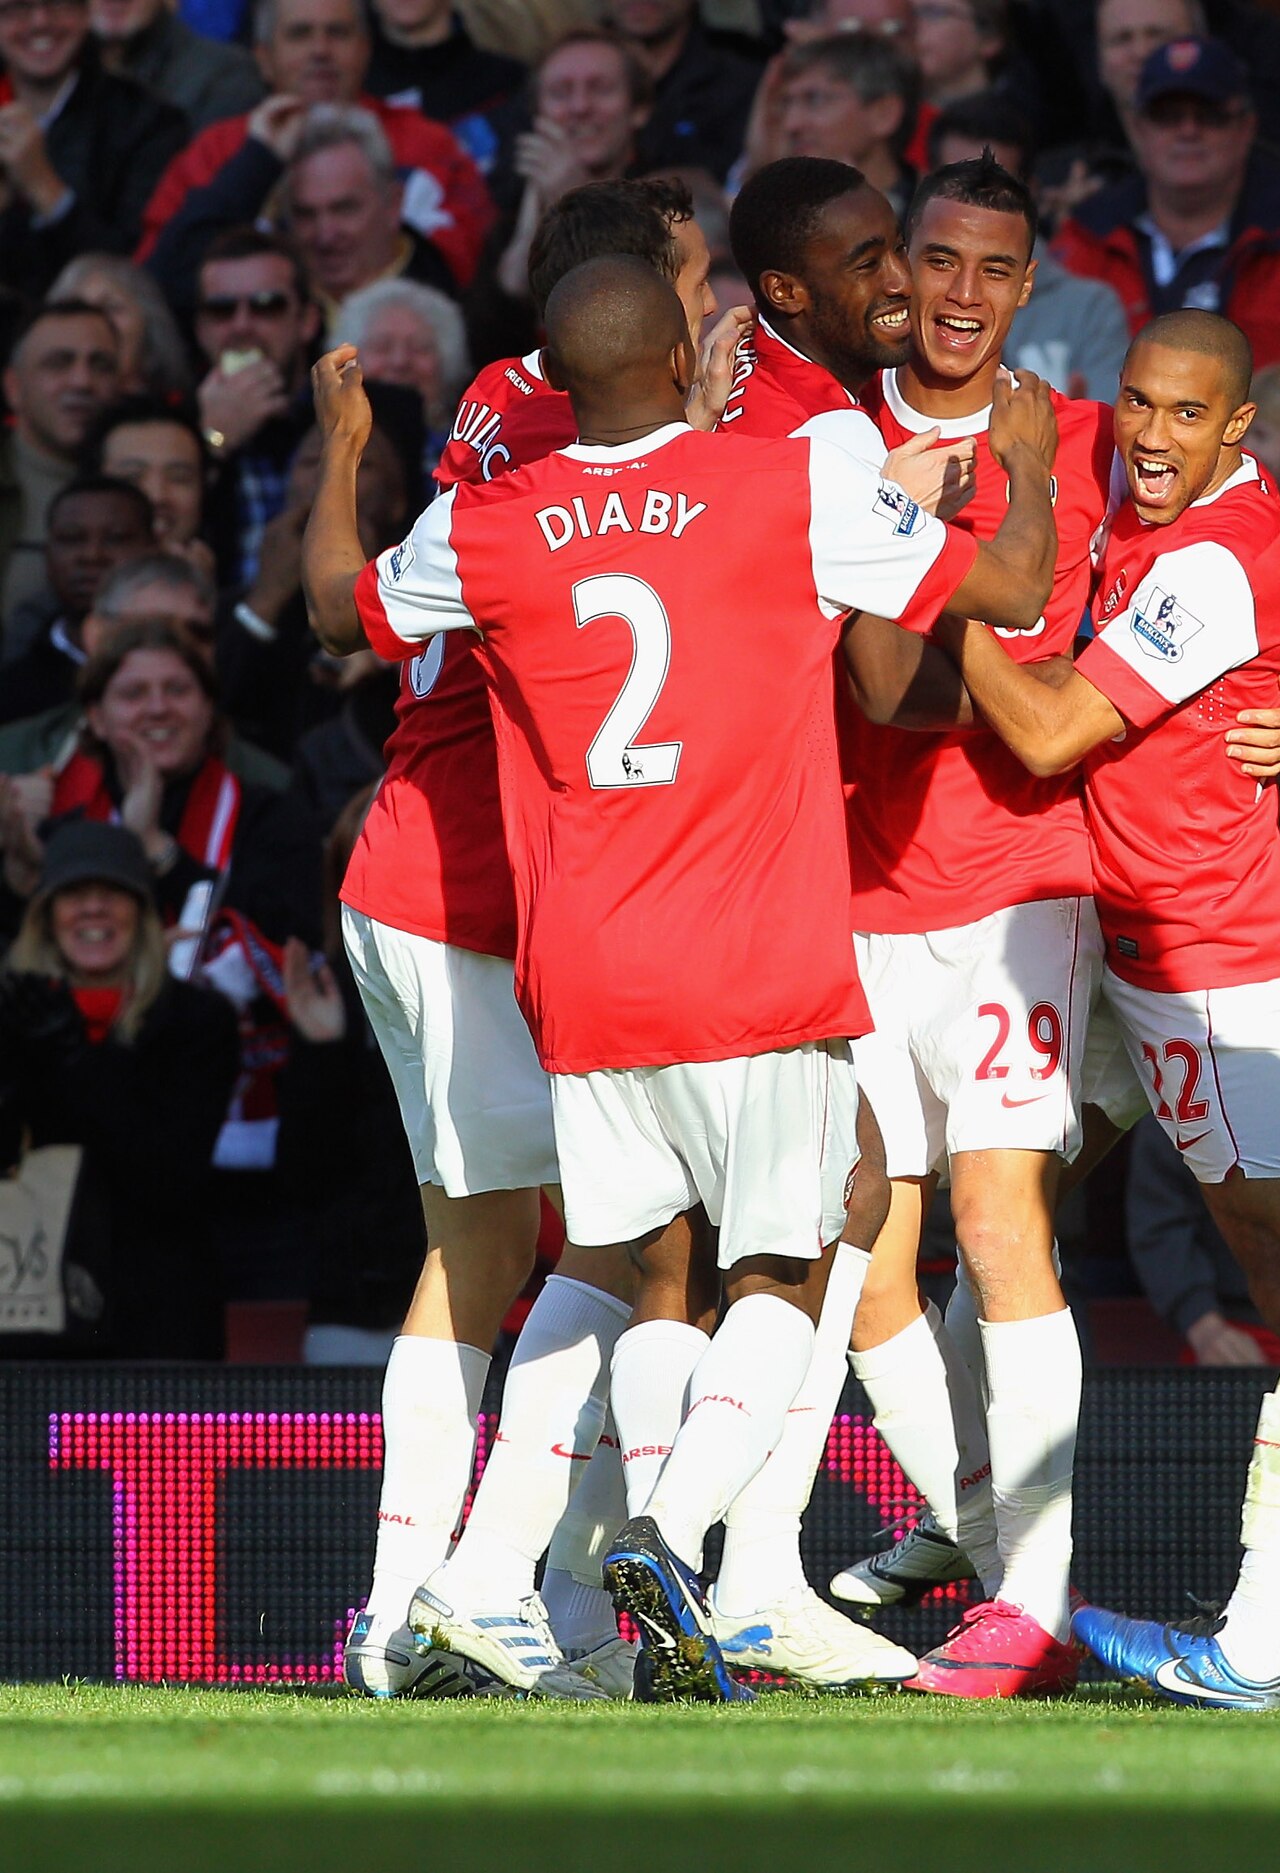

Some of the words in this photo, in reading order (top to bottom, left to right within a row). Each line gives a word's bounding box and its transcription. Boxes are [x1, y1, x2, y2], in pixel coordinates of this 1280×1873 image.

[534, 489, 708, 552] DIABY
[1137, 618, 1170, 649] BARCLAYS
[572, 572, 684, 790] 2
[974, 1000, 1065, 1081] 29
